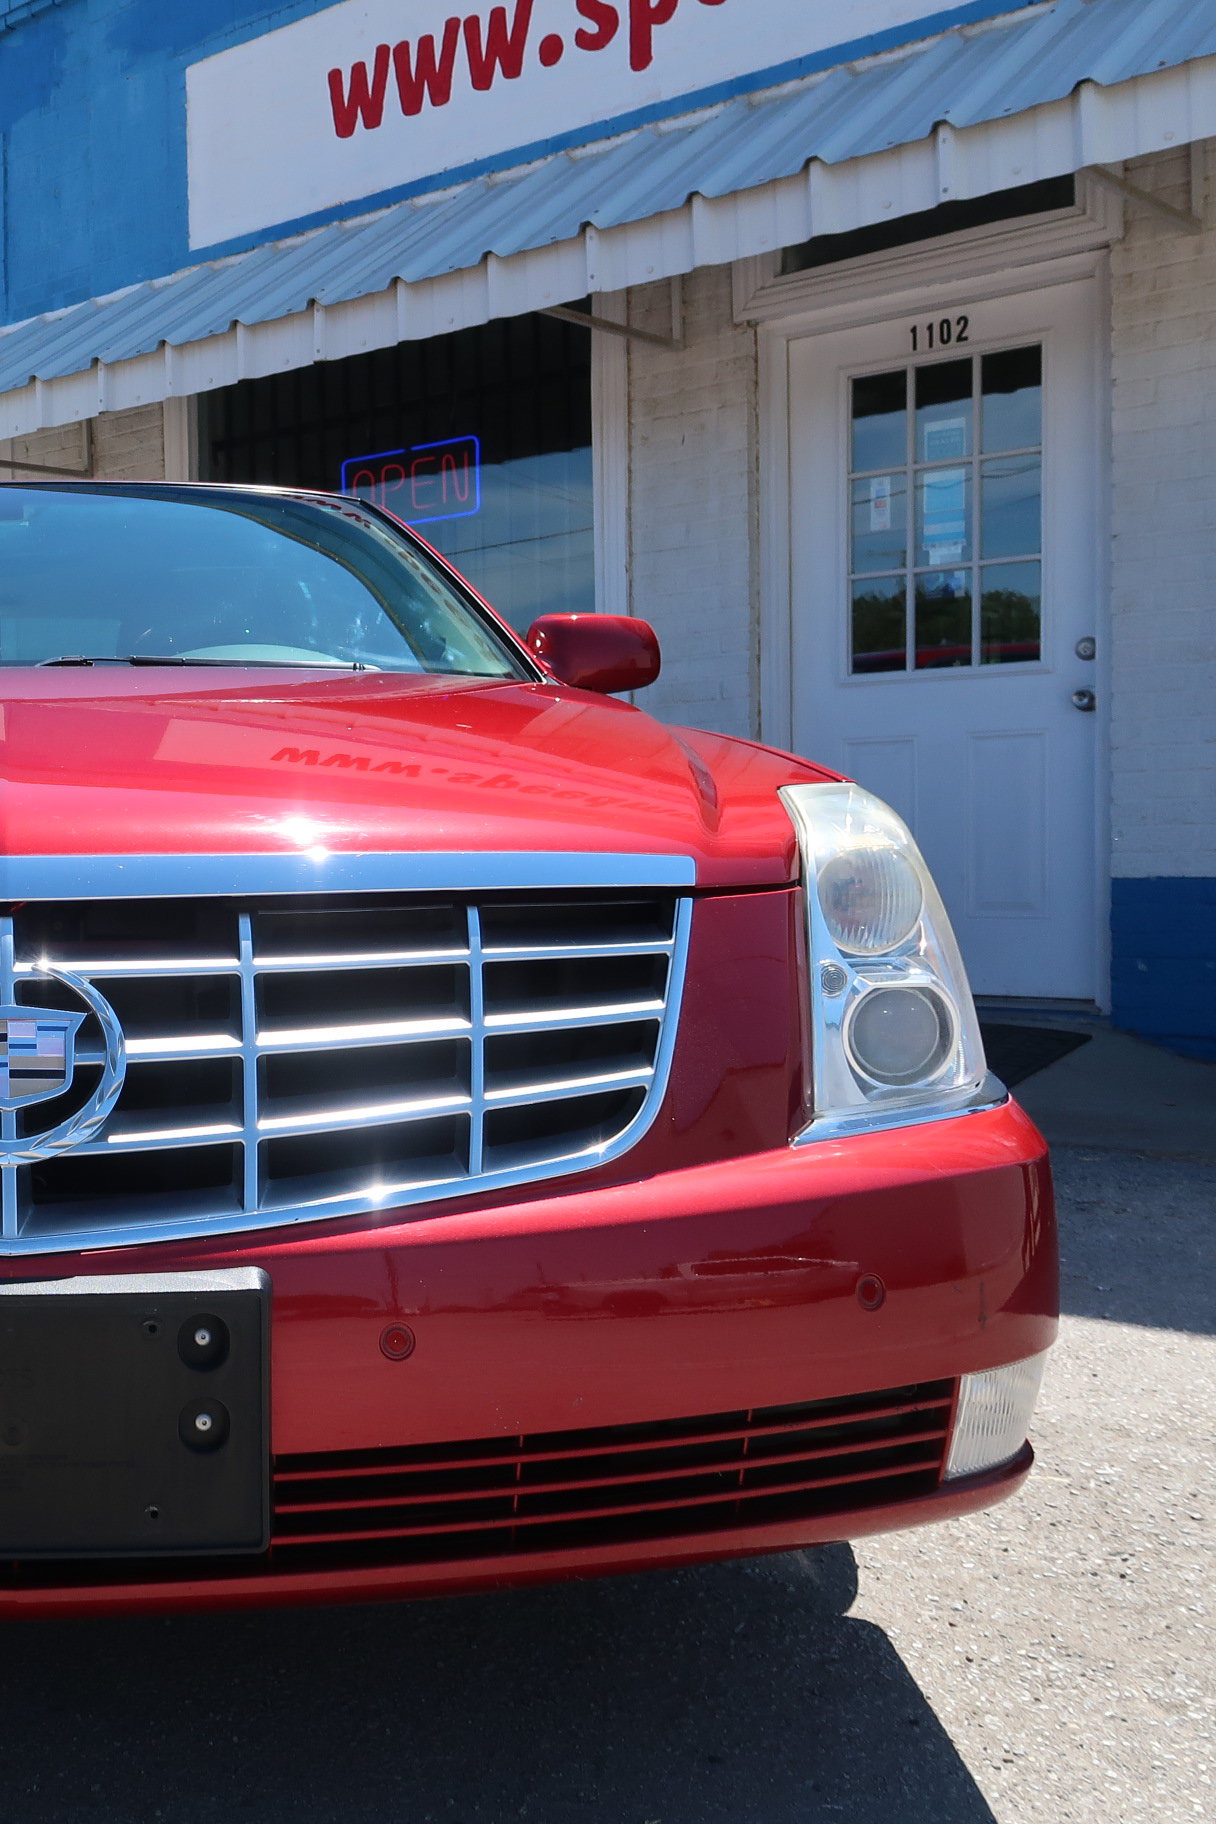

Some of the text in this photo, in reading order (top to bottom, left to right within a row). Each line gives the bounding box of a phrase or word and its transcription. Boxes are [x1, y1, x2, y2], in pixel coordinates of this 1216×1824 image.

[328, 0, 726, 138] www.sp
[910, 315, 969, 352] 1102
[352, 451, 469, 509] OPEN
